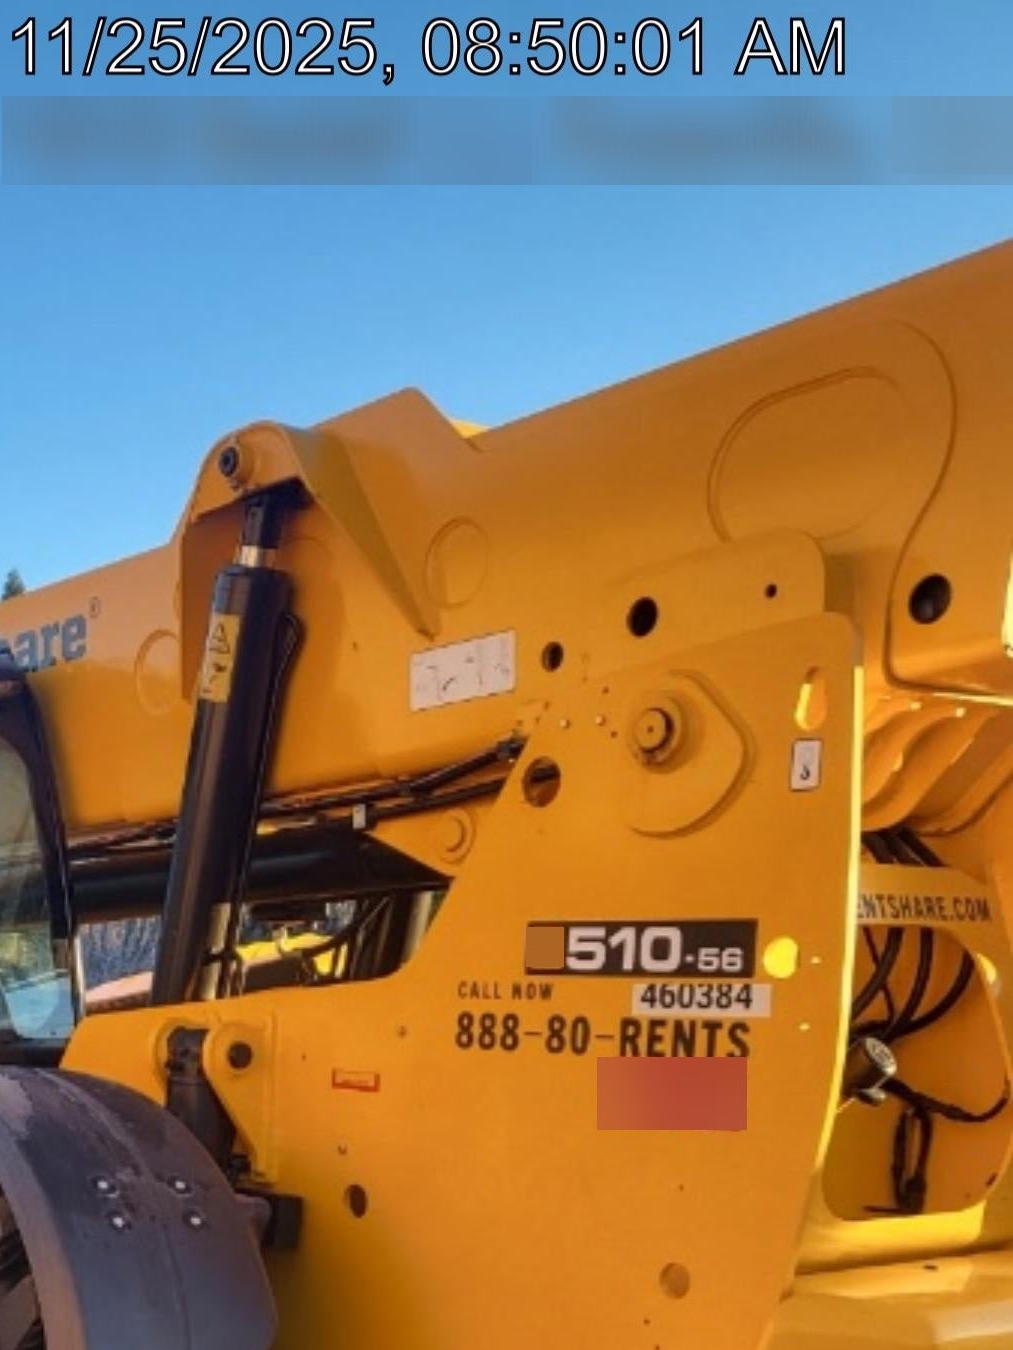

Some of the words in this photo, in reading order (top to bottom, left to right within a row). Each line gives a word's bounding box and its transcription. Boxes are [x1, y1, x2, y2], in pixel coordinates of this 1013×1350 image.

[458, 981, 501, 999] CALL
[512, 983, 554, 1000] NOW
[640, 983, 754, 1009] 460384
[455, 1011, 751, 1058] 888-80-RENTS
